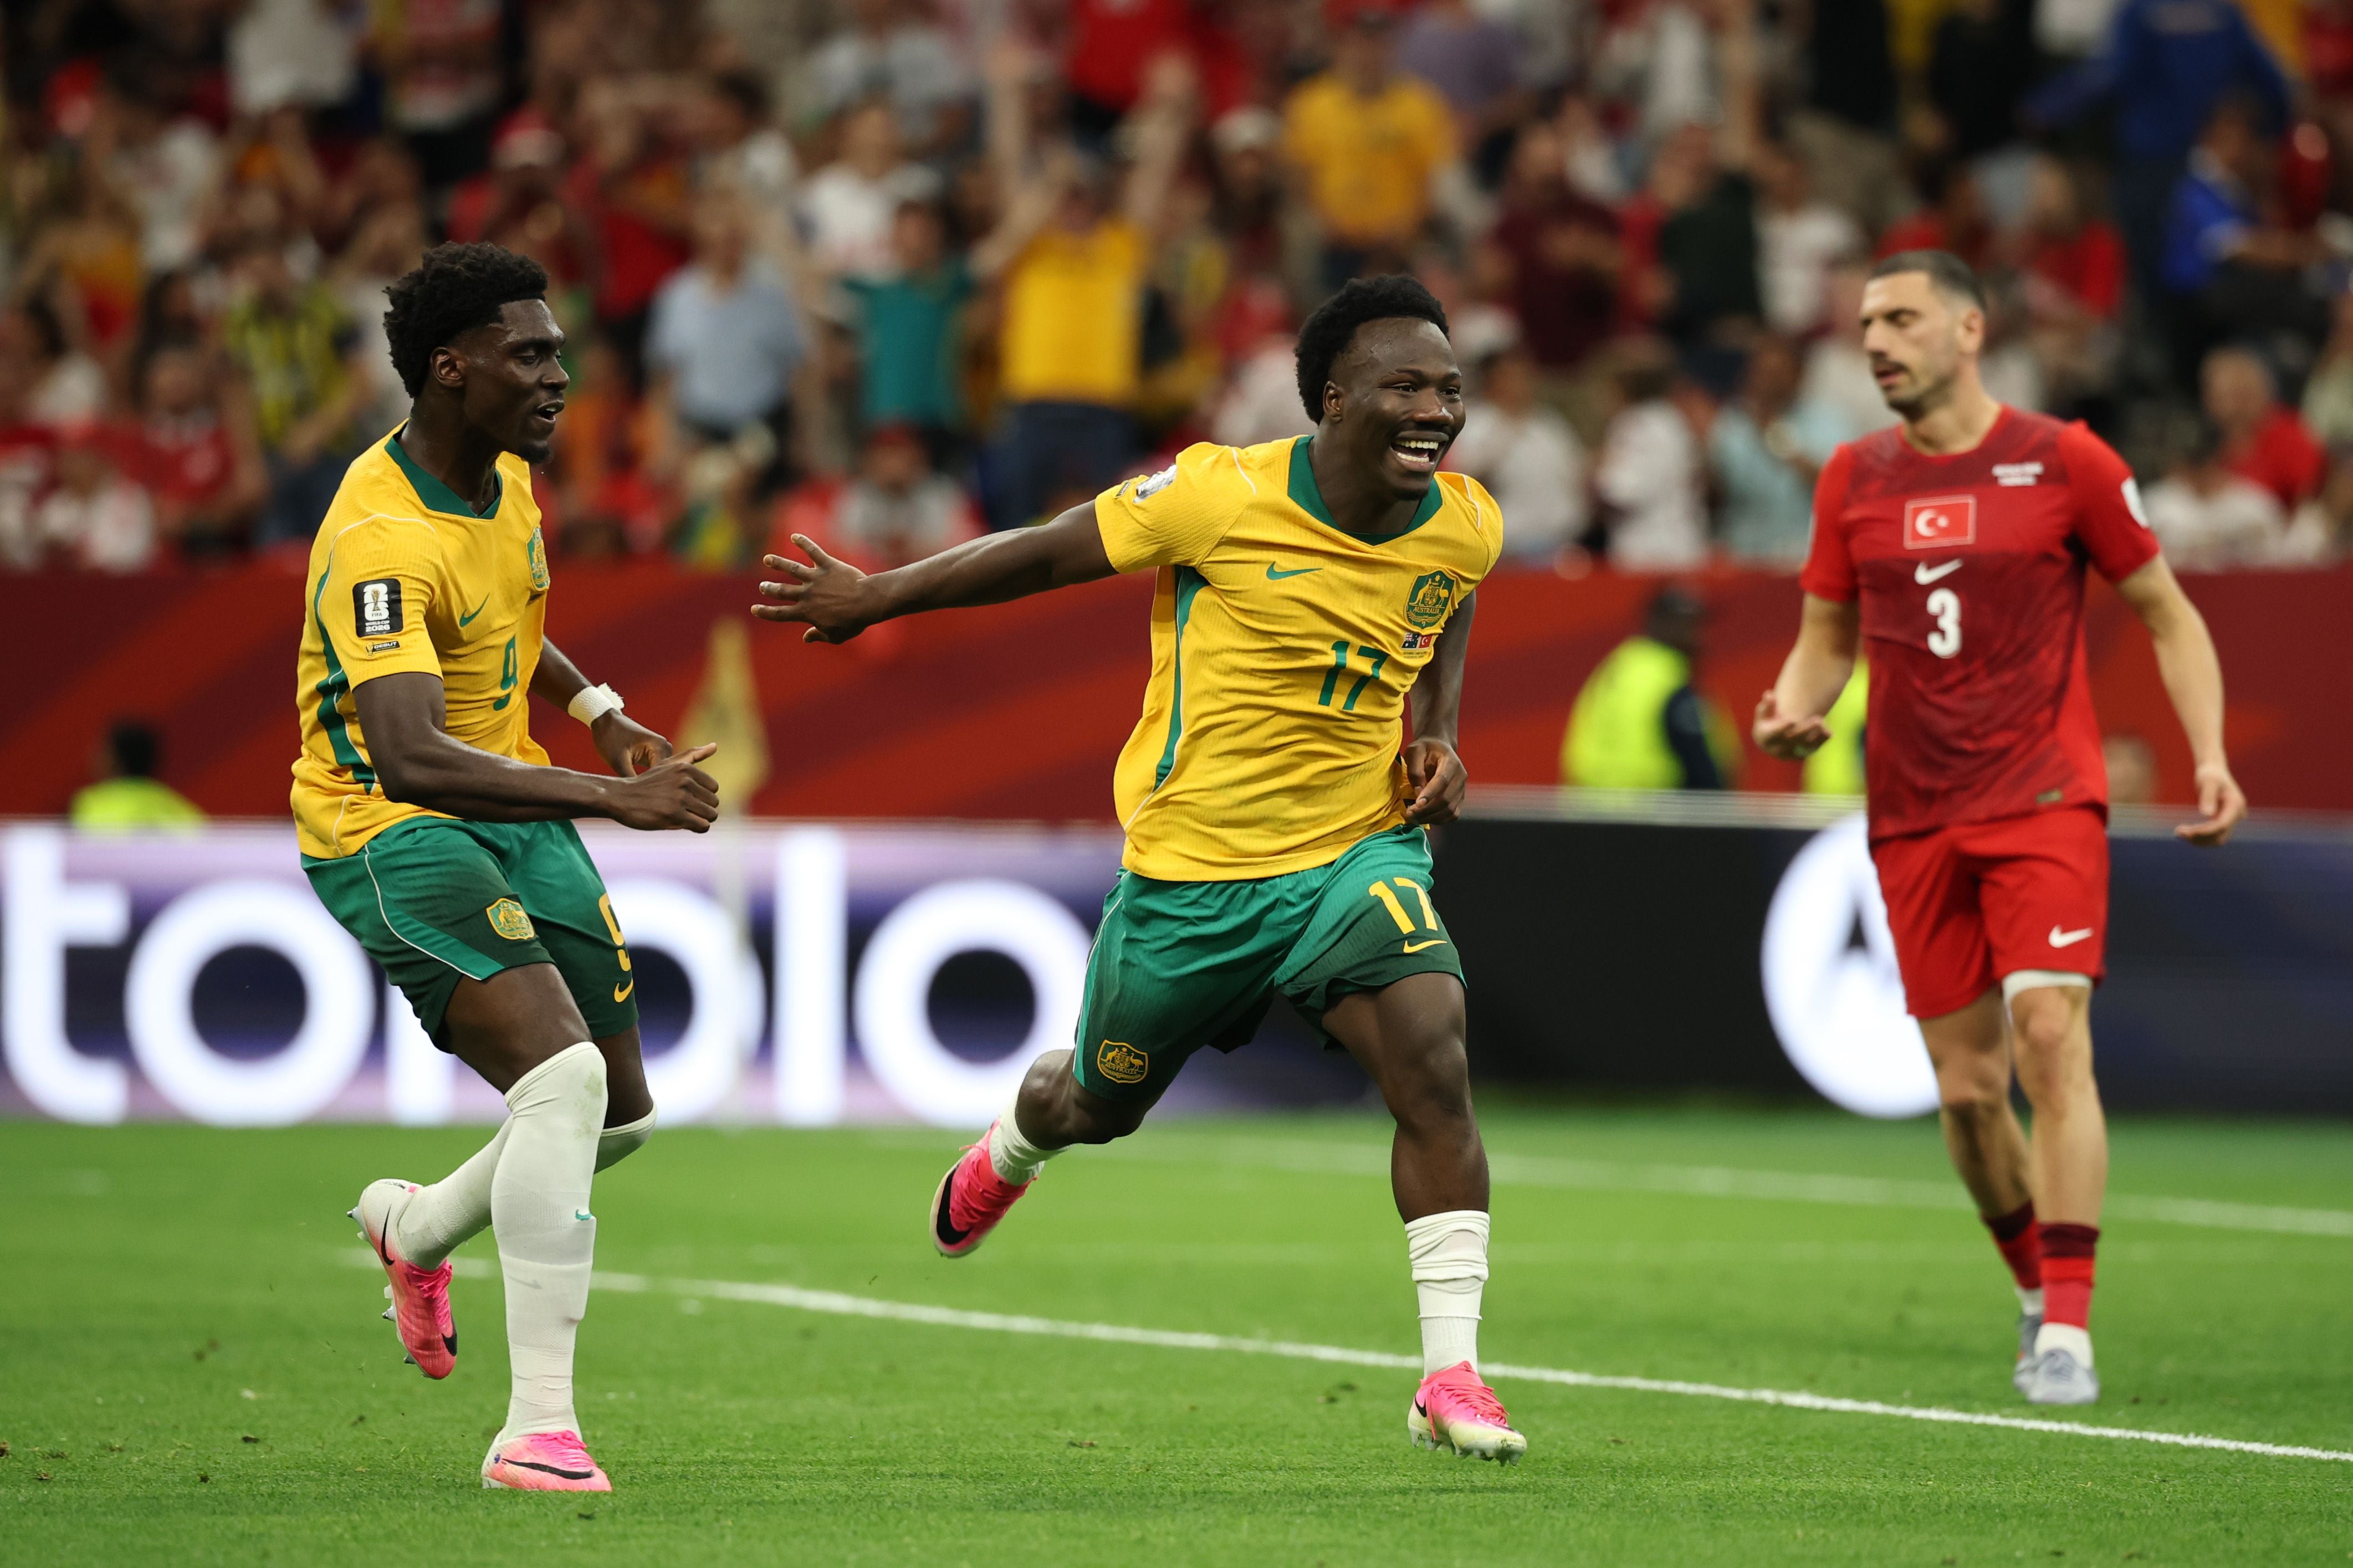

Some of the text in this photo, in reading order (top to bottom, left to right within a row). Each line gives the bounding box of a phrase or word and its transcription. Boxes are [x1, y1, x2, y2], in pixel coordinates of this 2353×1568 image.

[365, 624, 390, 632] 2026
[1926, 587, 1962, 659] 3
[493, 635, 518, 711] 9
[1318, 640, 1390, 711] 17
[1368, 877, 1439, 935] 17
[1105, 1063, 1137, 1074] AUSTRALIA
